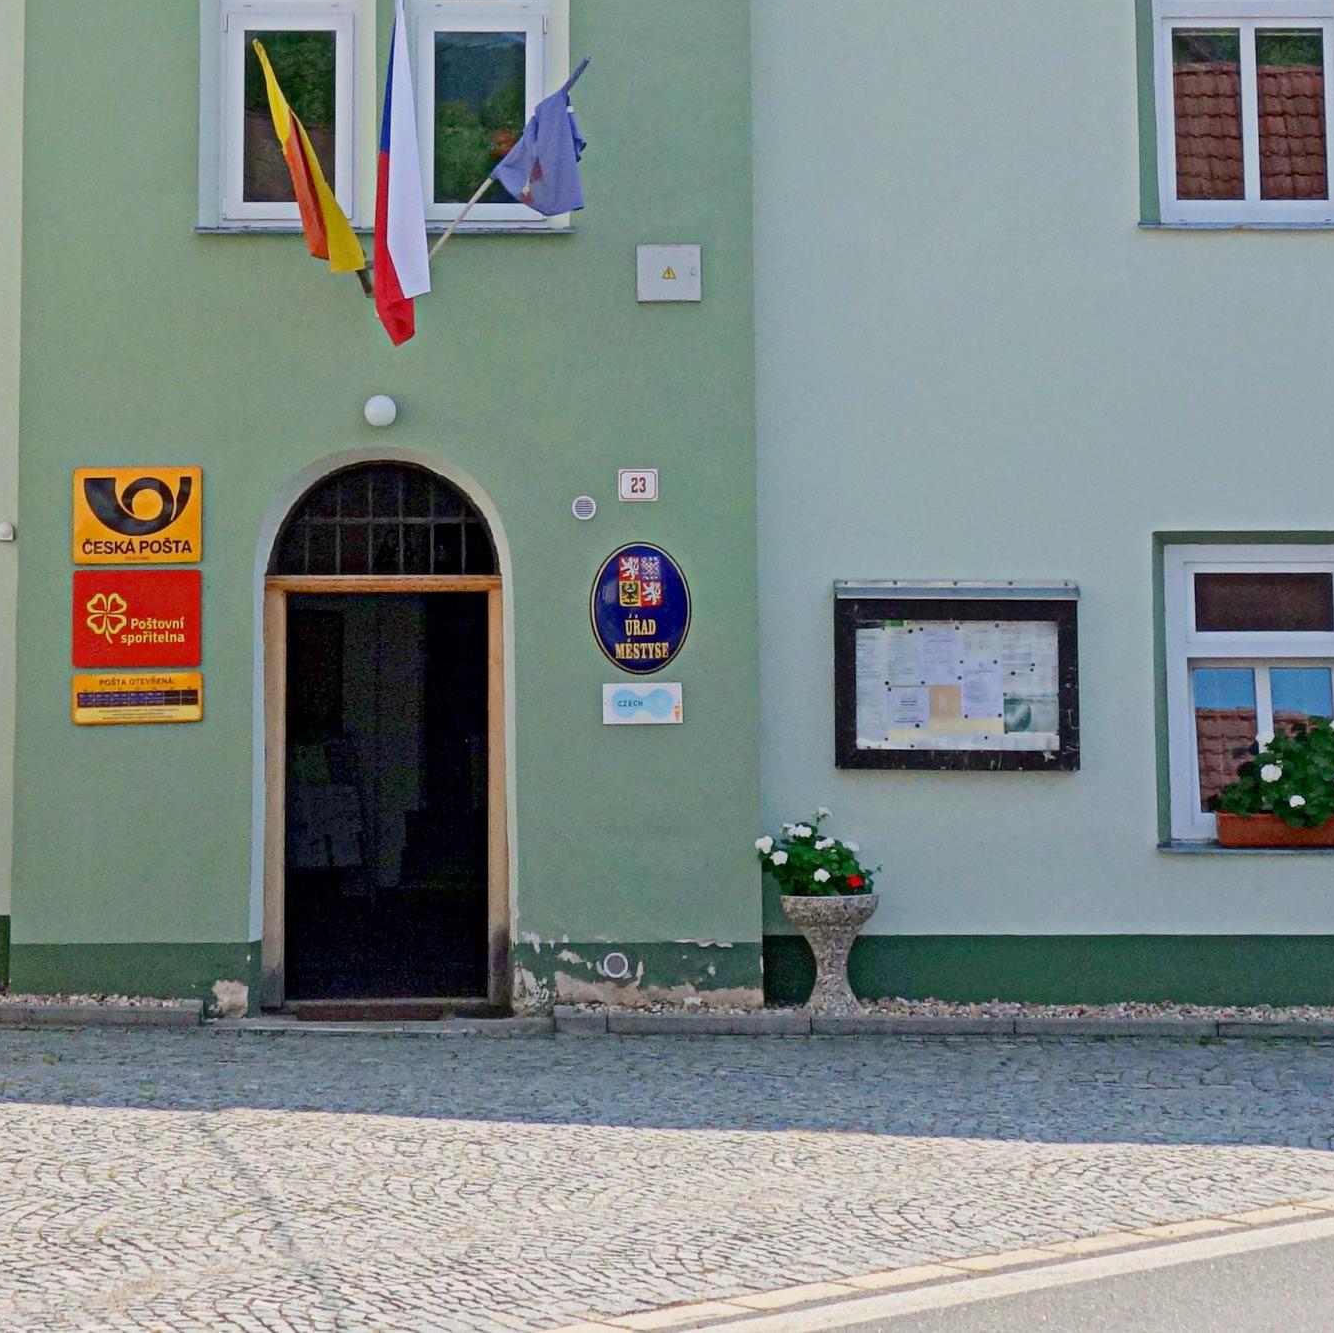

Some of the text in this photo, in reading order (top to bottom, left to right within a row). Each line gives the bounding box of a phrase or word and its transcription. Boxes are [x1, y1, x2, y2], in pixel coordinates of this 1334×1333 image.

[631, 477, 647, 493] 23
[82, 537, 192, 555] ČESKÁ POŠTA
[130, 616, 185, 630] Poštovní
[624, 613, 657, 636] ÚŘAD
[120, 630, 186, 646] spořitelna
[614, 637, 670, 659] MĚSTYSE
[99, 676, 127, 686] POŠTA
[617, 699, 644, 707] CZECH
